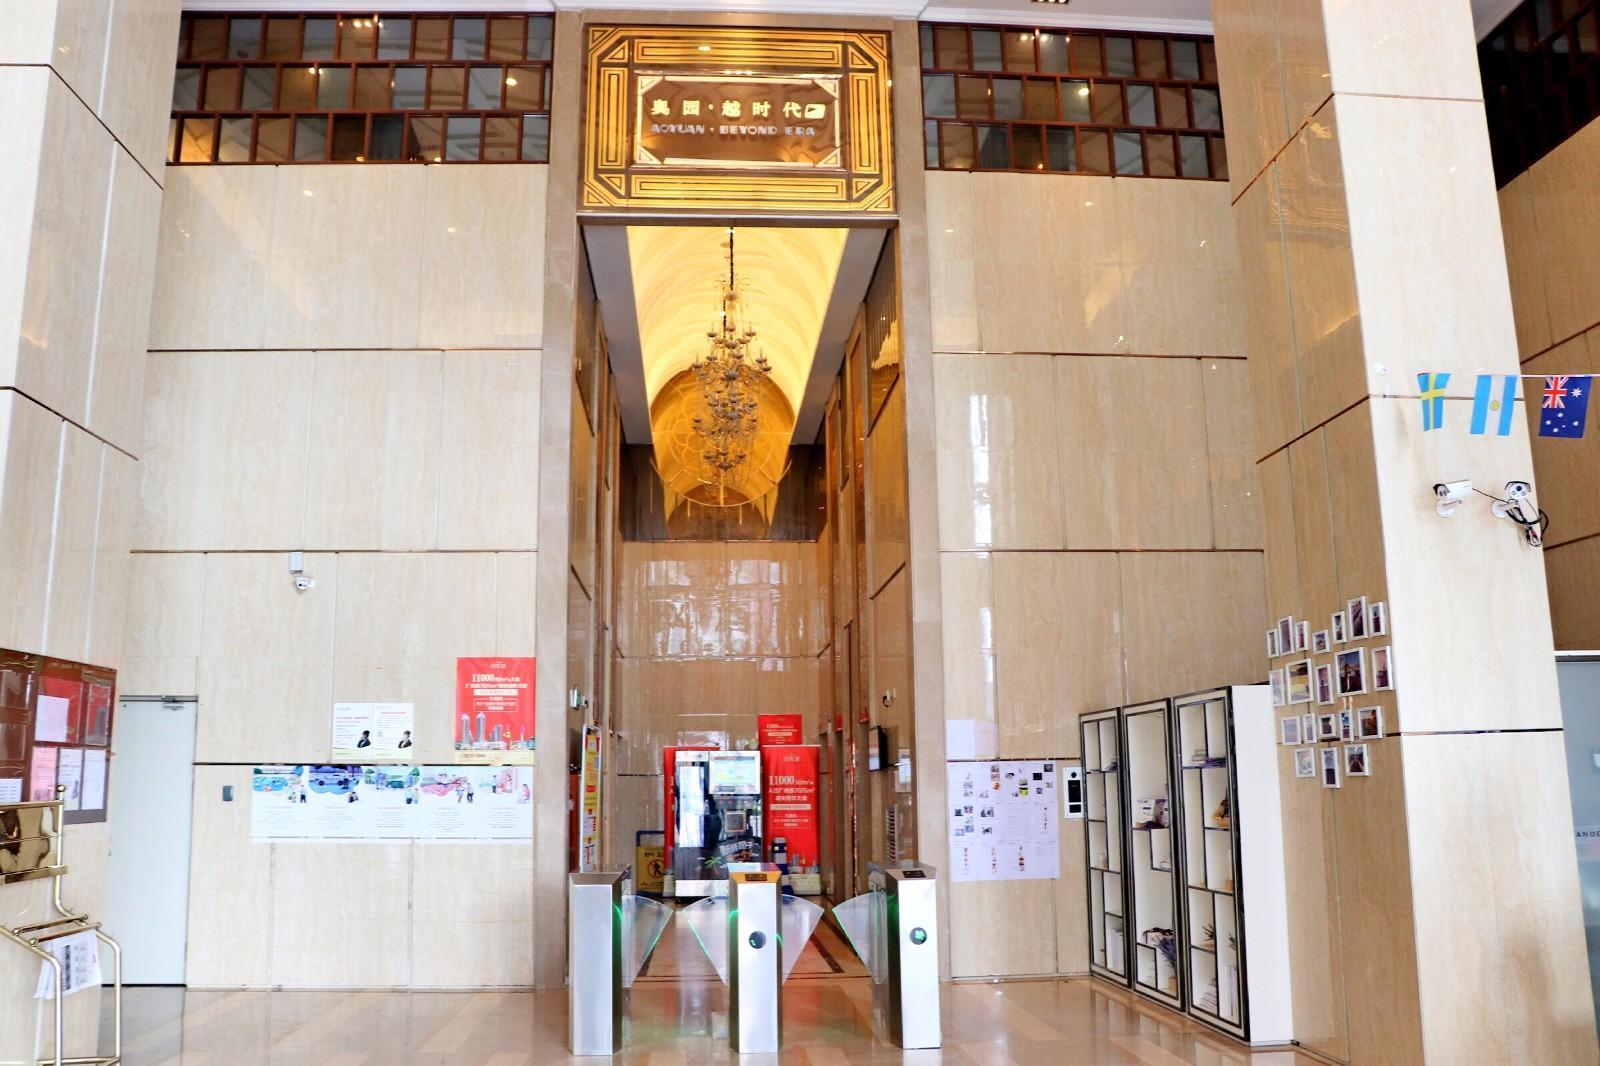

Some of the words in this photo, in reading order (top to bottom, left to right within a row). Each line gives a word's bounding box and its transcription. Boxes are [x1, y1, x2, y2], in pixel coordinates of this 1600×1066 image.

[651, 124, 705, 135] AOYUAN
[719, 125, 778, 135] BEYOND
[785, 126, 815, 136] ERA
[768, 775, 795, 786] 11000
